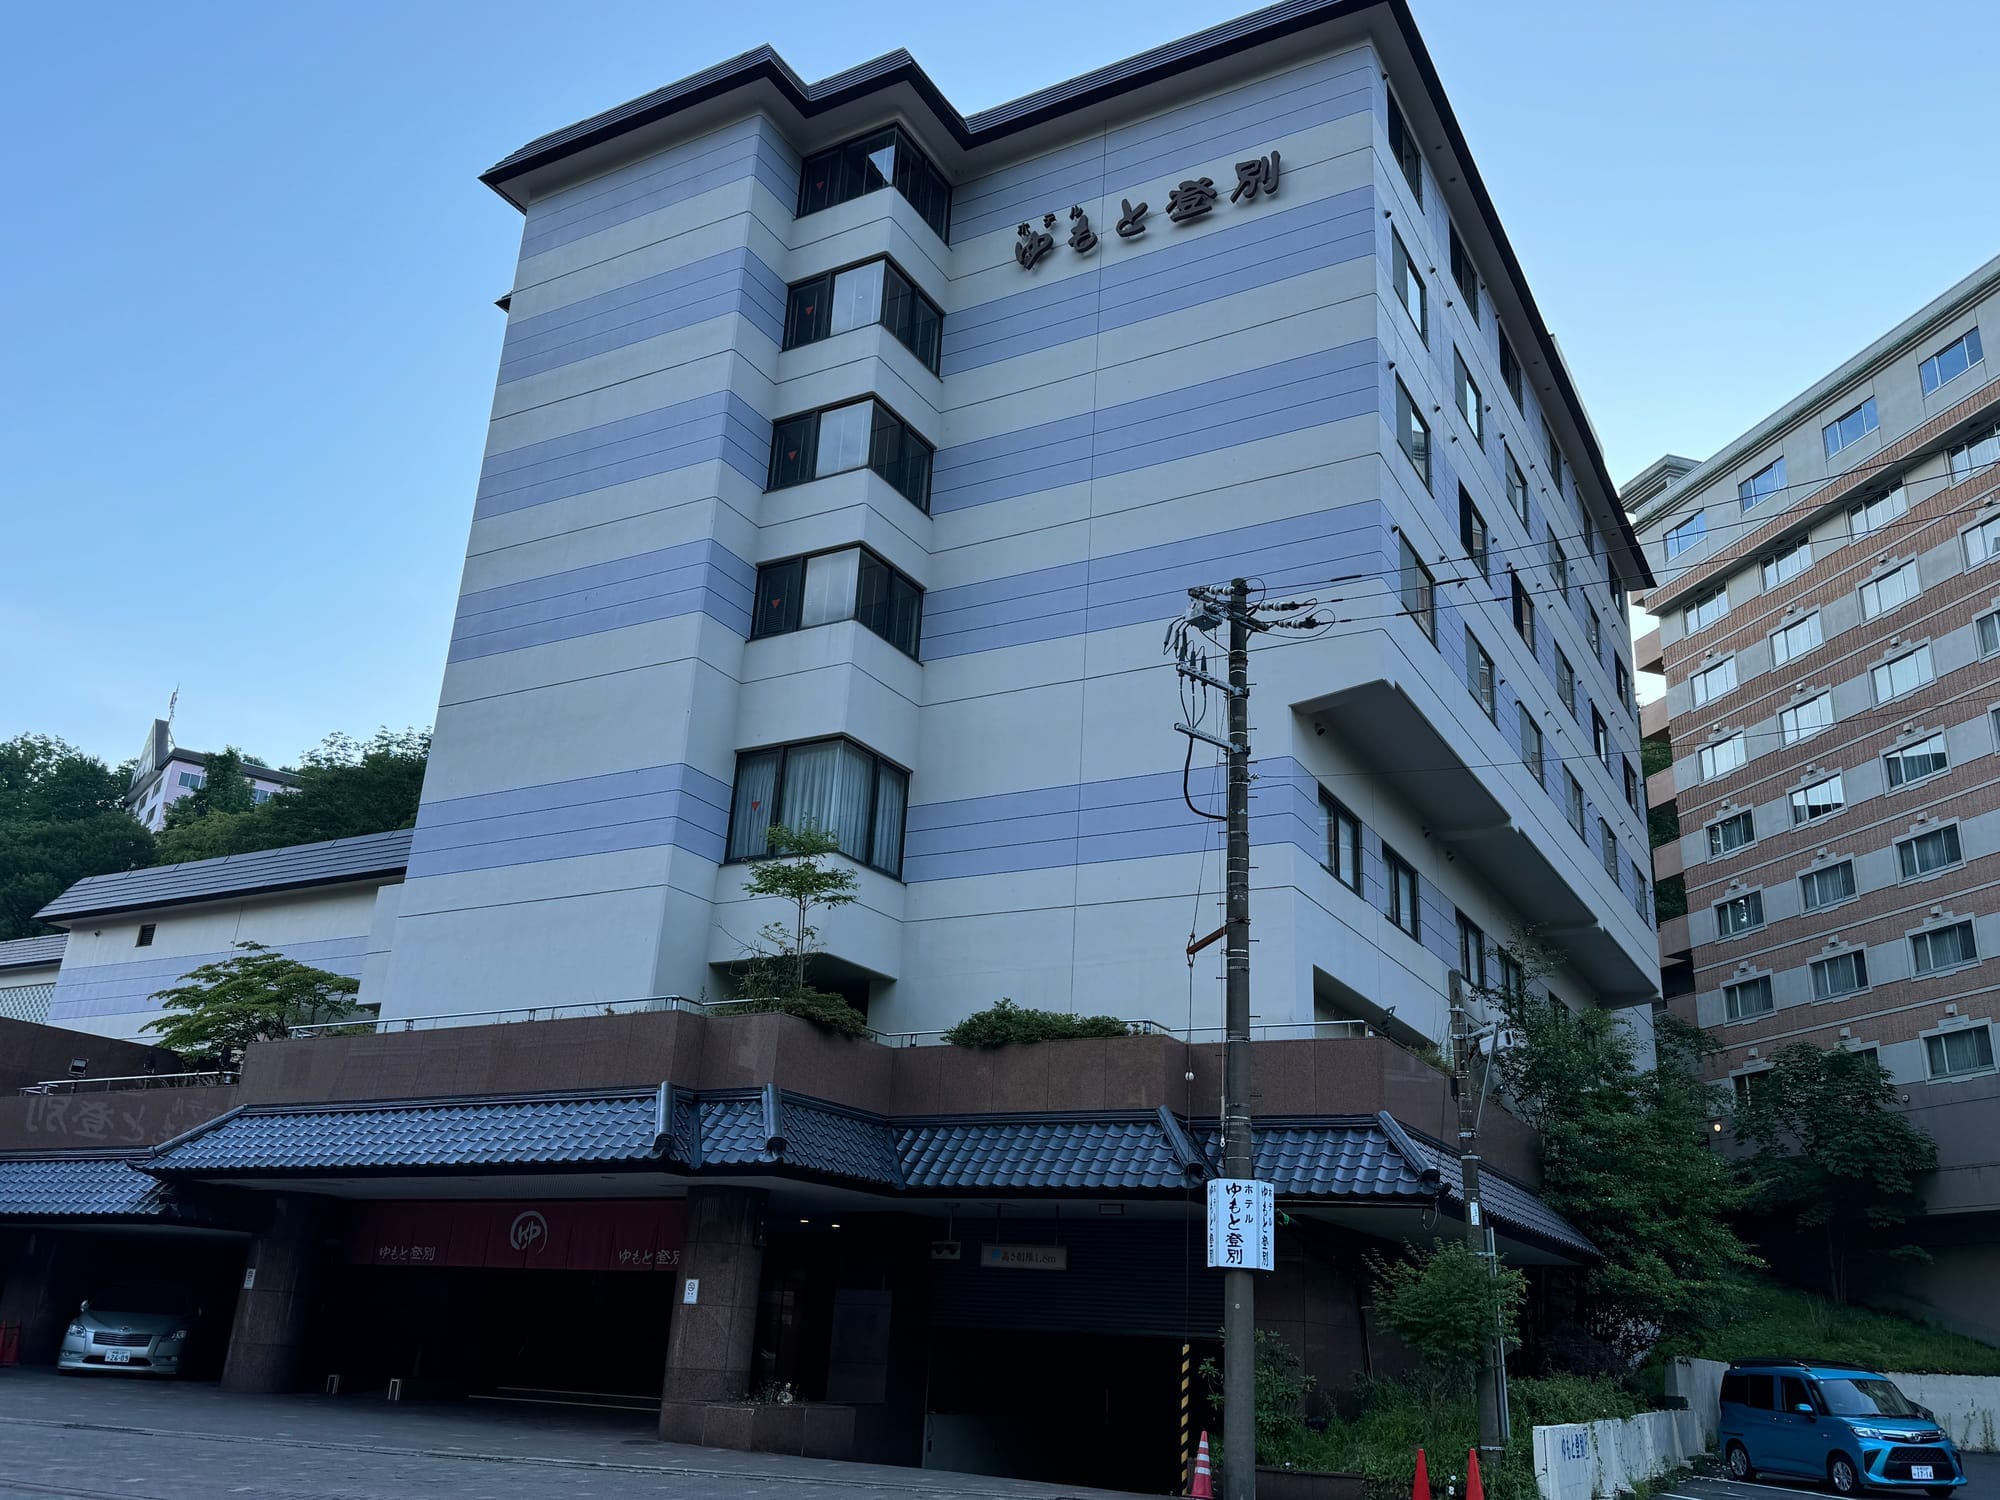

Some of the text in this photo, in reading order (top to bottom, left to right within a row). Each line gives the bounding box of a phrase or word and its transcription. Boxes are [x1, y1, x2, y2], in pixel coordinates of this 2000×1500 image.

[1014, 149, 1281, 271] ゆもと登別
[1017, 204, 1084, 239] ホテル
[1245, 1184, 1254, 1223] ホテル
[1225, 1182, 1244, 1265] ゆもと登別
[378, 1245, 436, 1261] ゆもと登別
